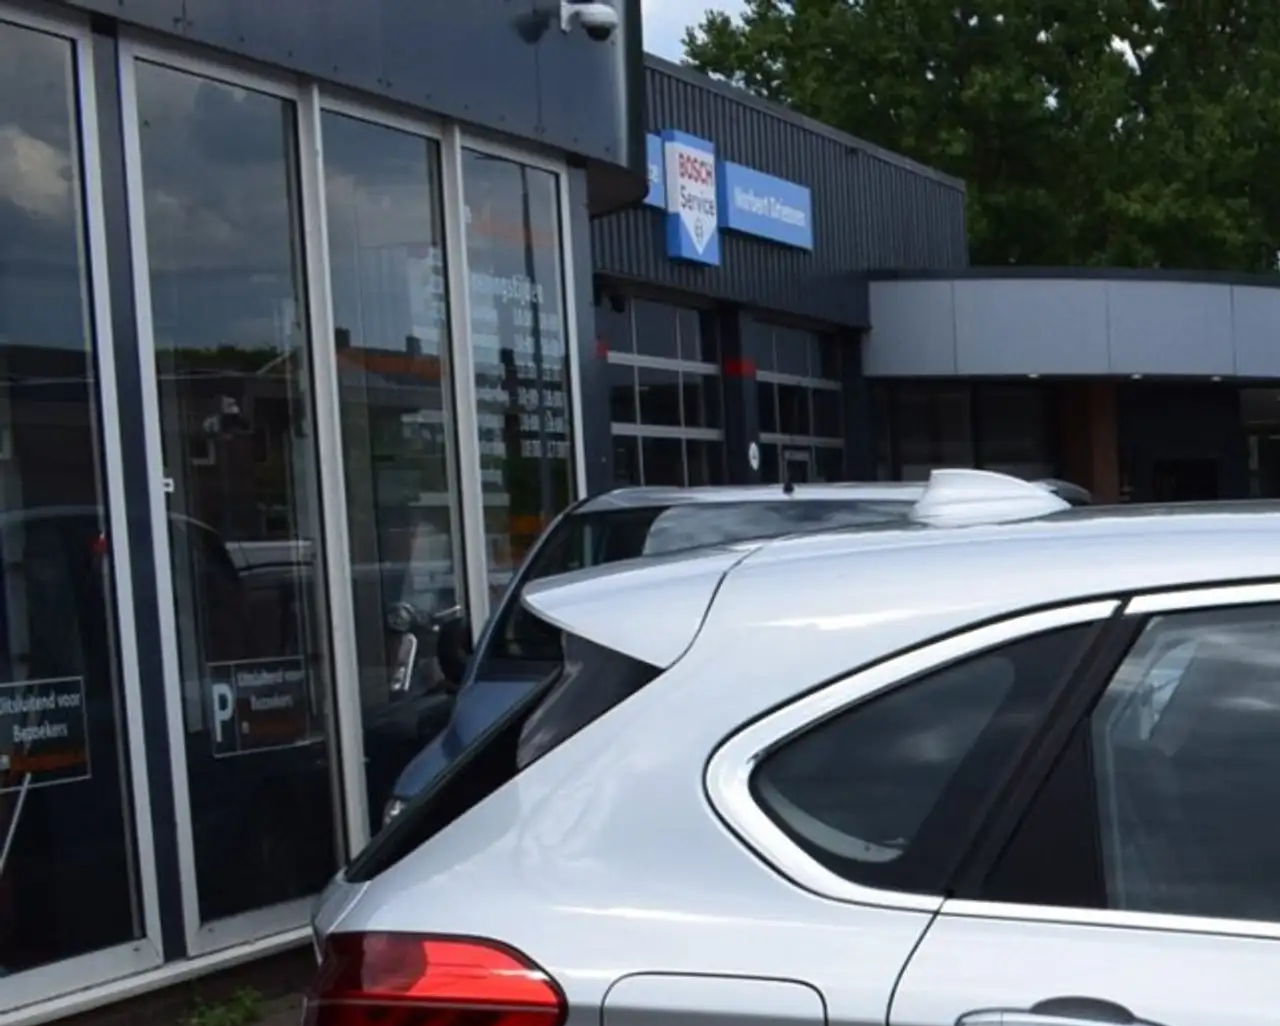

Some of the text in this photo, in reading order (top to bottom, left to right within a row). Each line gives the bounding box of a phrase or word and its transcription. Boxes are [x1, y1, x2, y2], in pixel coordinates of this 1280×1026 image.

[678, 152, 713, 187] BOSCH
[680, 185, 716, 216] Service
[212, 682, 233, 742] P
